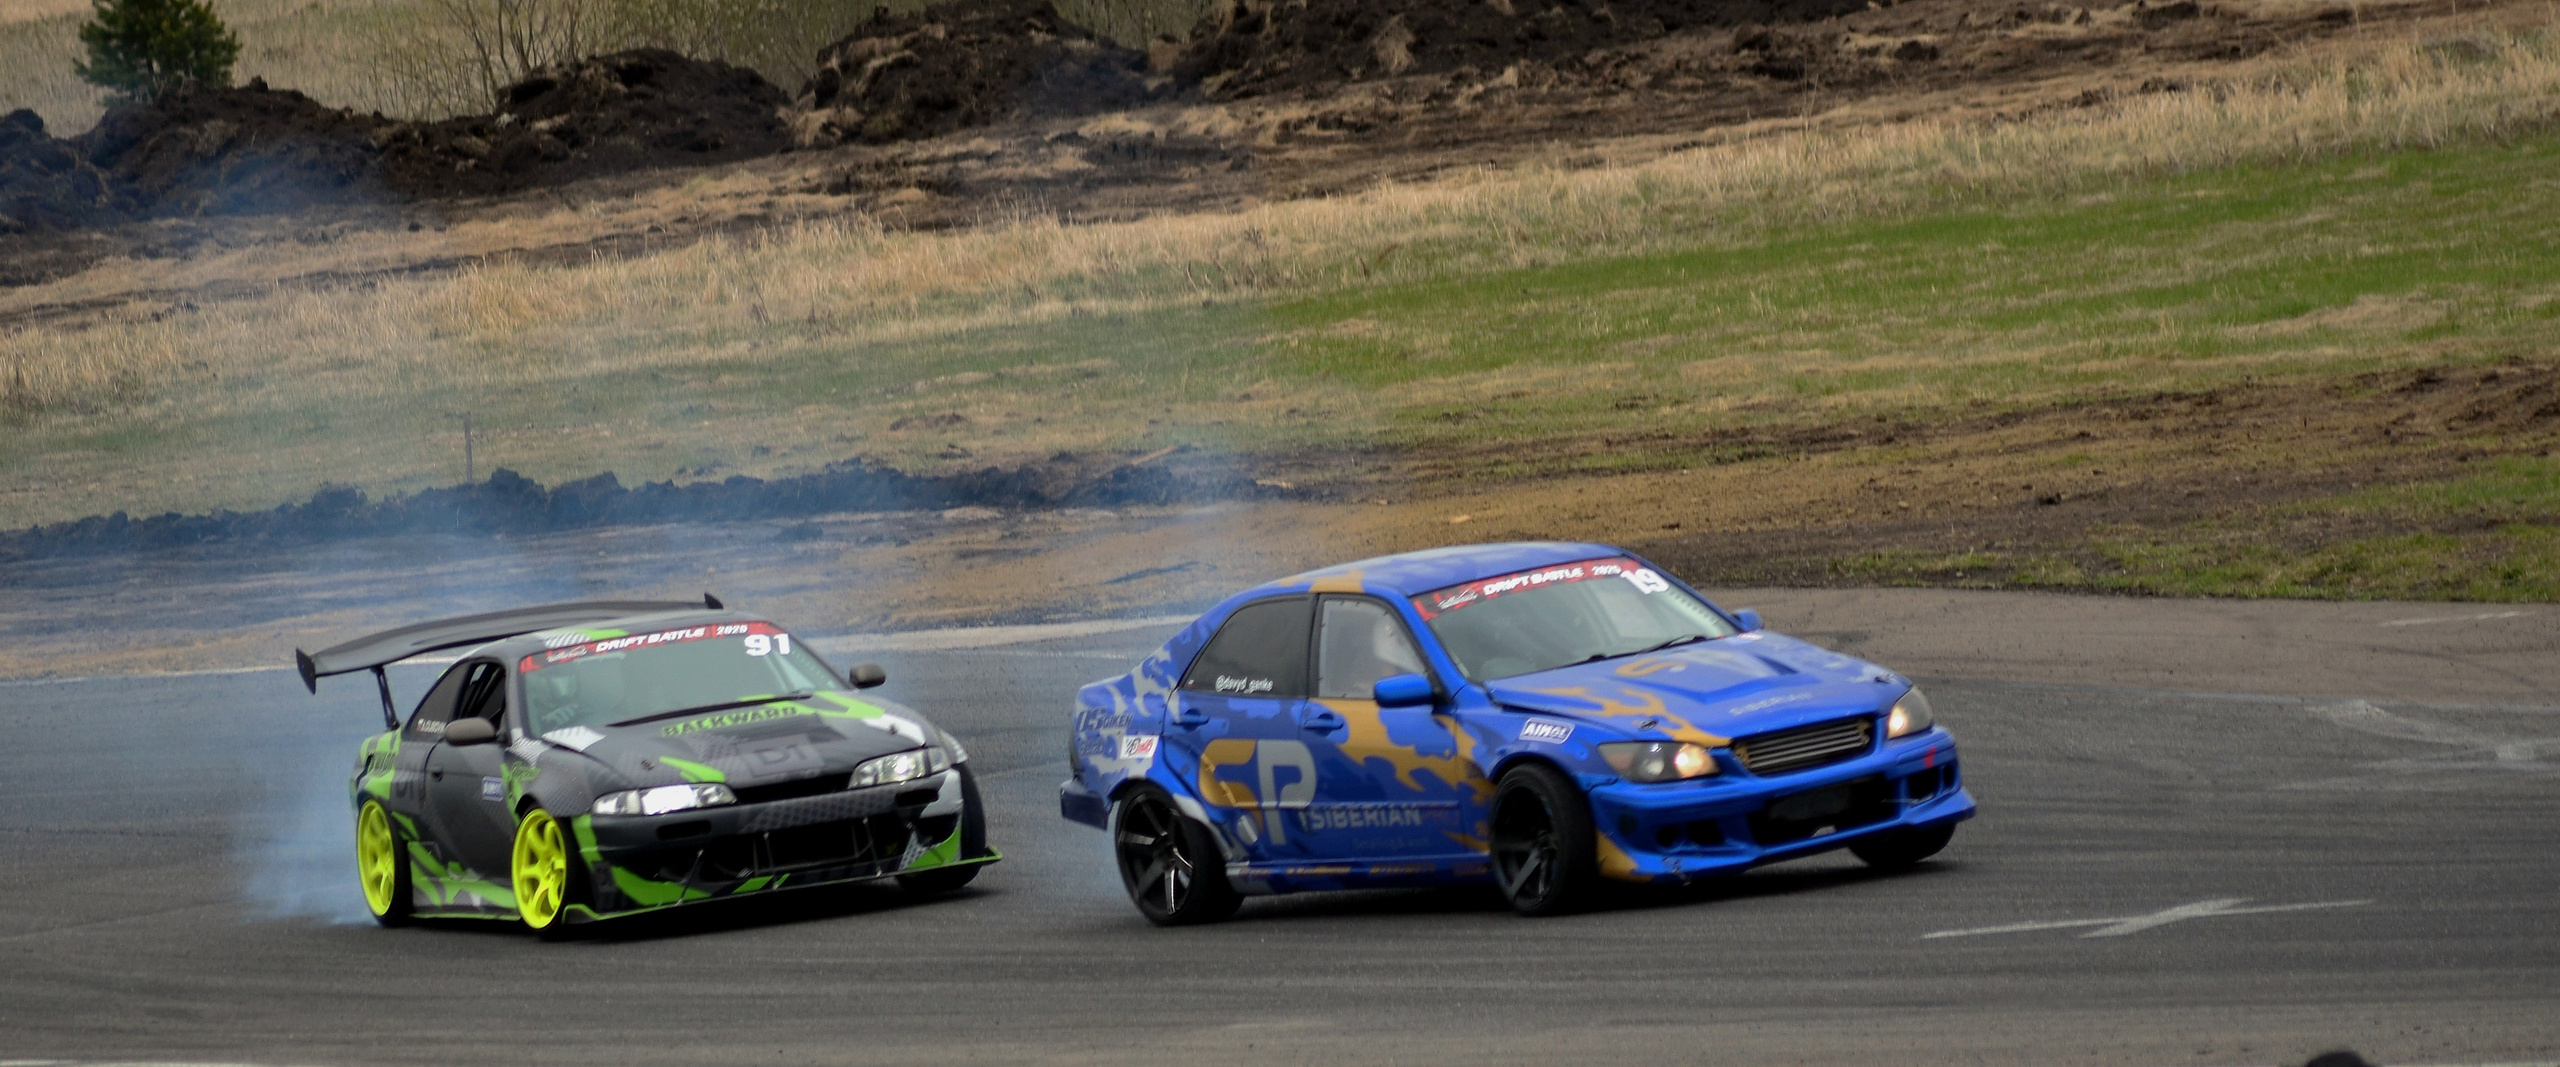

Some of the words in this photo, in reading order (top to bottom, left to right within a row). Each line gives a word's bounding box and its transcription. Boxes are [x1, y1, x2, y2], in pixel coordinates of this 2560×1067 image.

[1483, 575, 1530, 596] DRIFT
[1530, 567, 1585, 585] BATTLE
[1620, 568, 1670, 594] 19
[595, 635, 648, 653] DRIFT
[647, 627, 706, 646] BATTLE
[744, 633, 791, 657] 91
[1308, 803, 1422, 831] SIBERIAN
